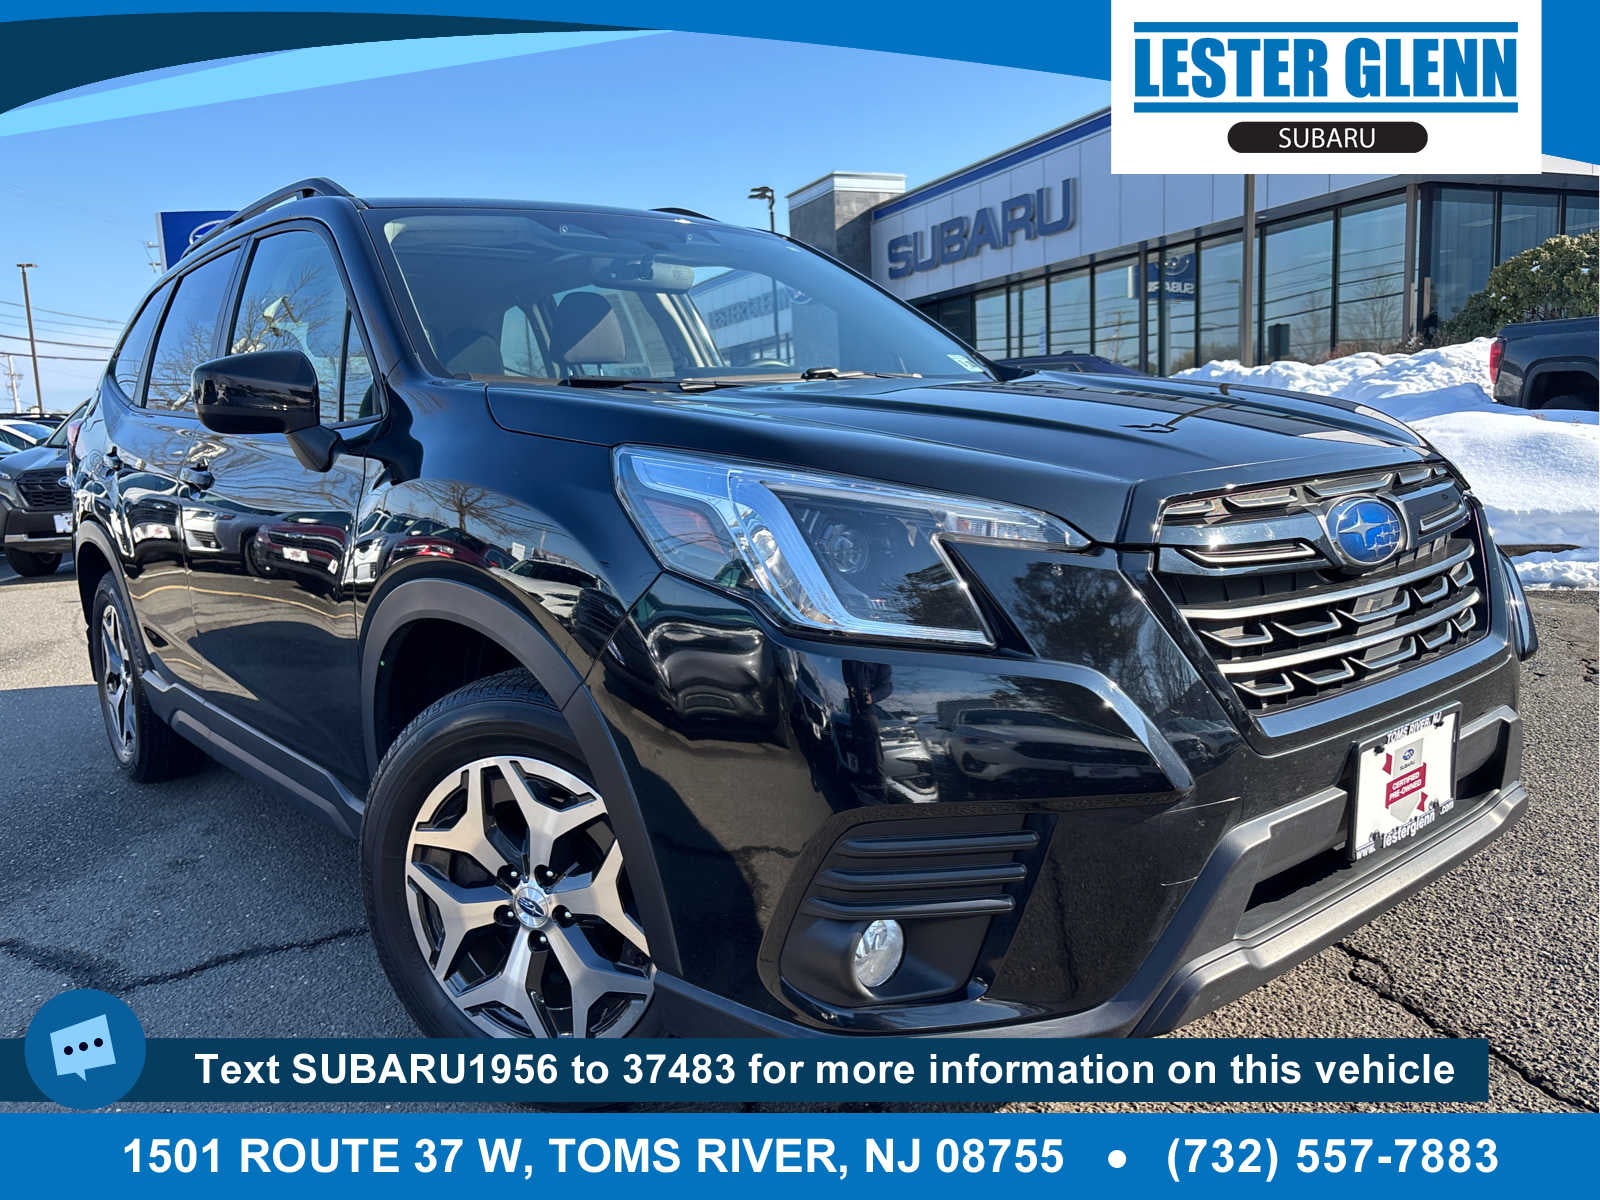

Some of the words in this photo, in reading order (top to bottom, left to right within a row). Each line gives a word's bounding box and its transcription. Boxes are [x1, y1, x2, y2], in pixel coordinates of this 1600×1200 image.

[888, 178, 1076, 280] SUBARU
[1386, 726, 1408, 744] TOMS
[1383, 811, 1436, 848] lesterglenn
